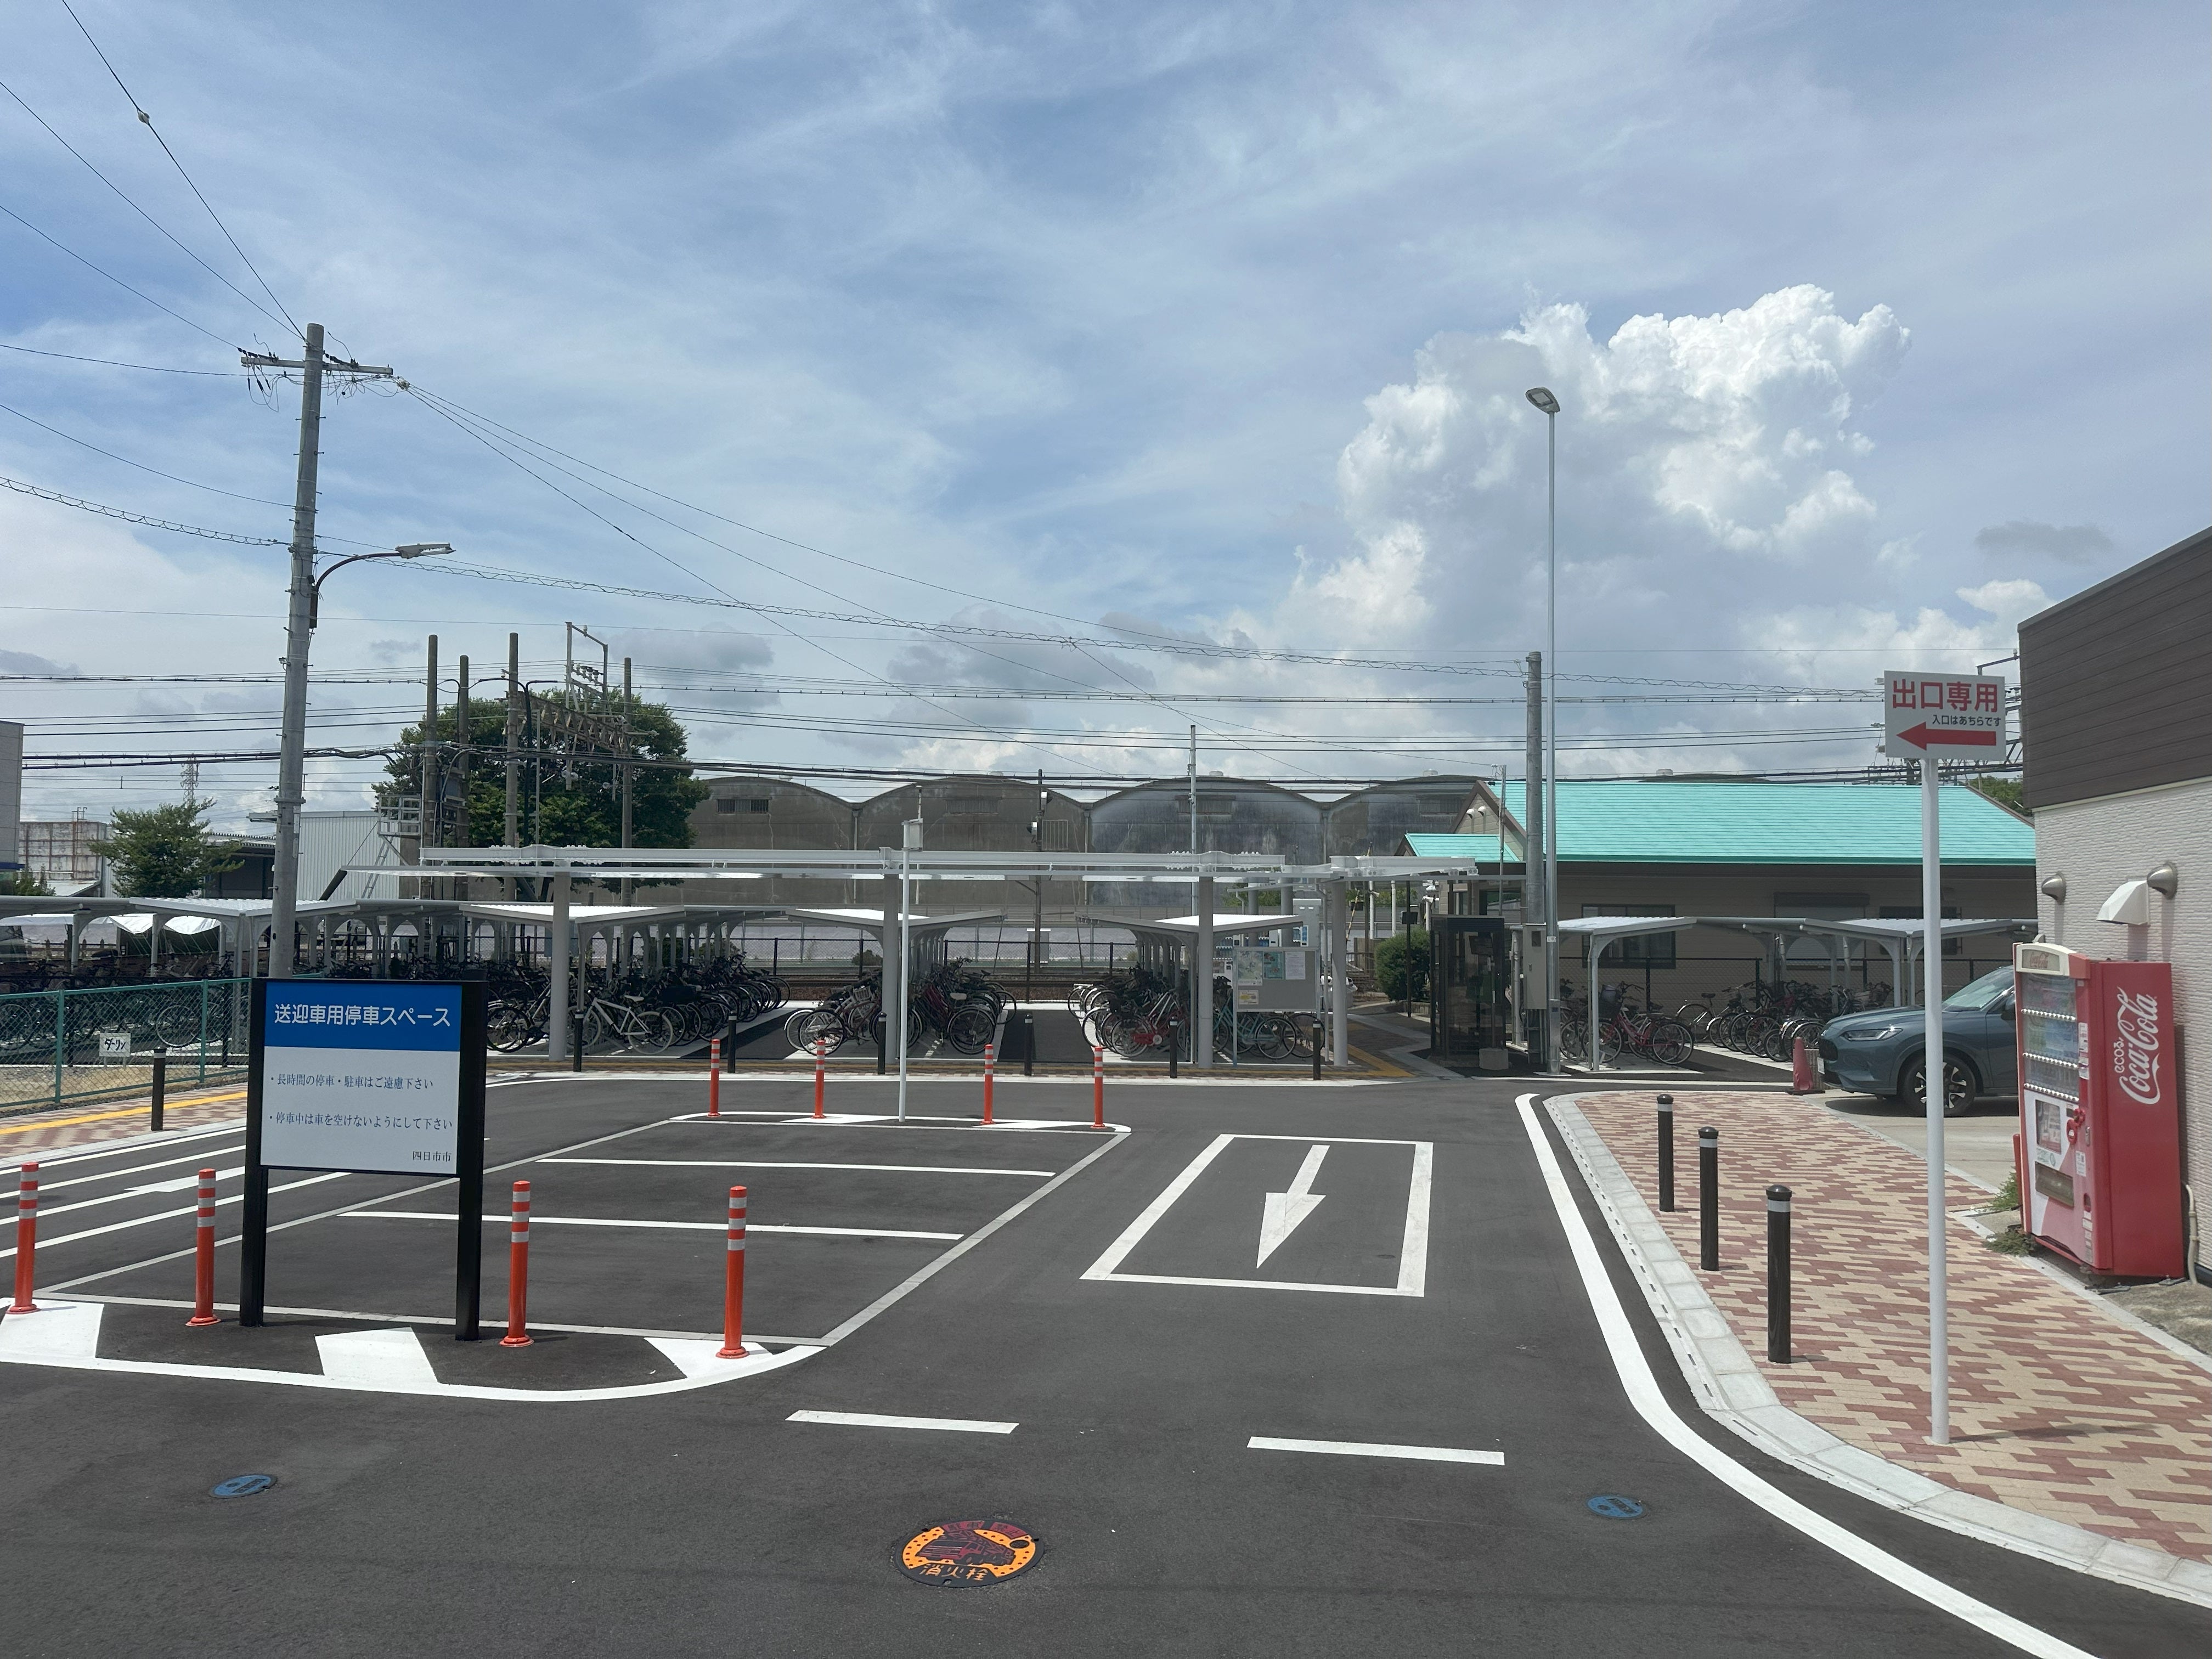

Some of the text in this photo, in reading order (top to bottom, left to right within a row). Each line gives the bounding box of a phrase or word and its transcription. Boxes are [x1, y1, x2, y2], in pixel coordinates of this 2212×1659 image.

[1892, 679, 1998, 713] 出口専用
[1932, 714, 2001, 727] 入口はあちらです
[274, 1003, 450, 1027] 送迎車用停車スペース
[2117, 986, 2160, 1105] Coca-Cola
[412, 1150, 452, 1163] 四日市市
[919, 1564, 988, 1581] 消火栓
